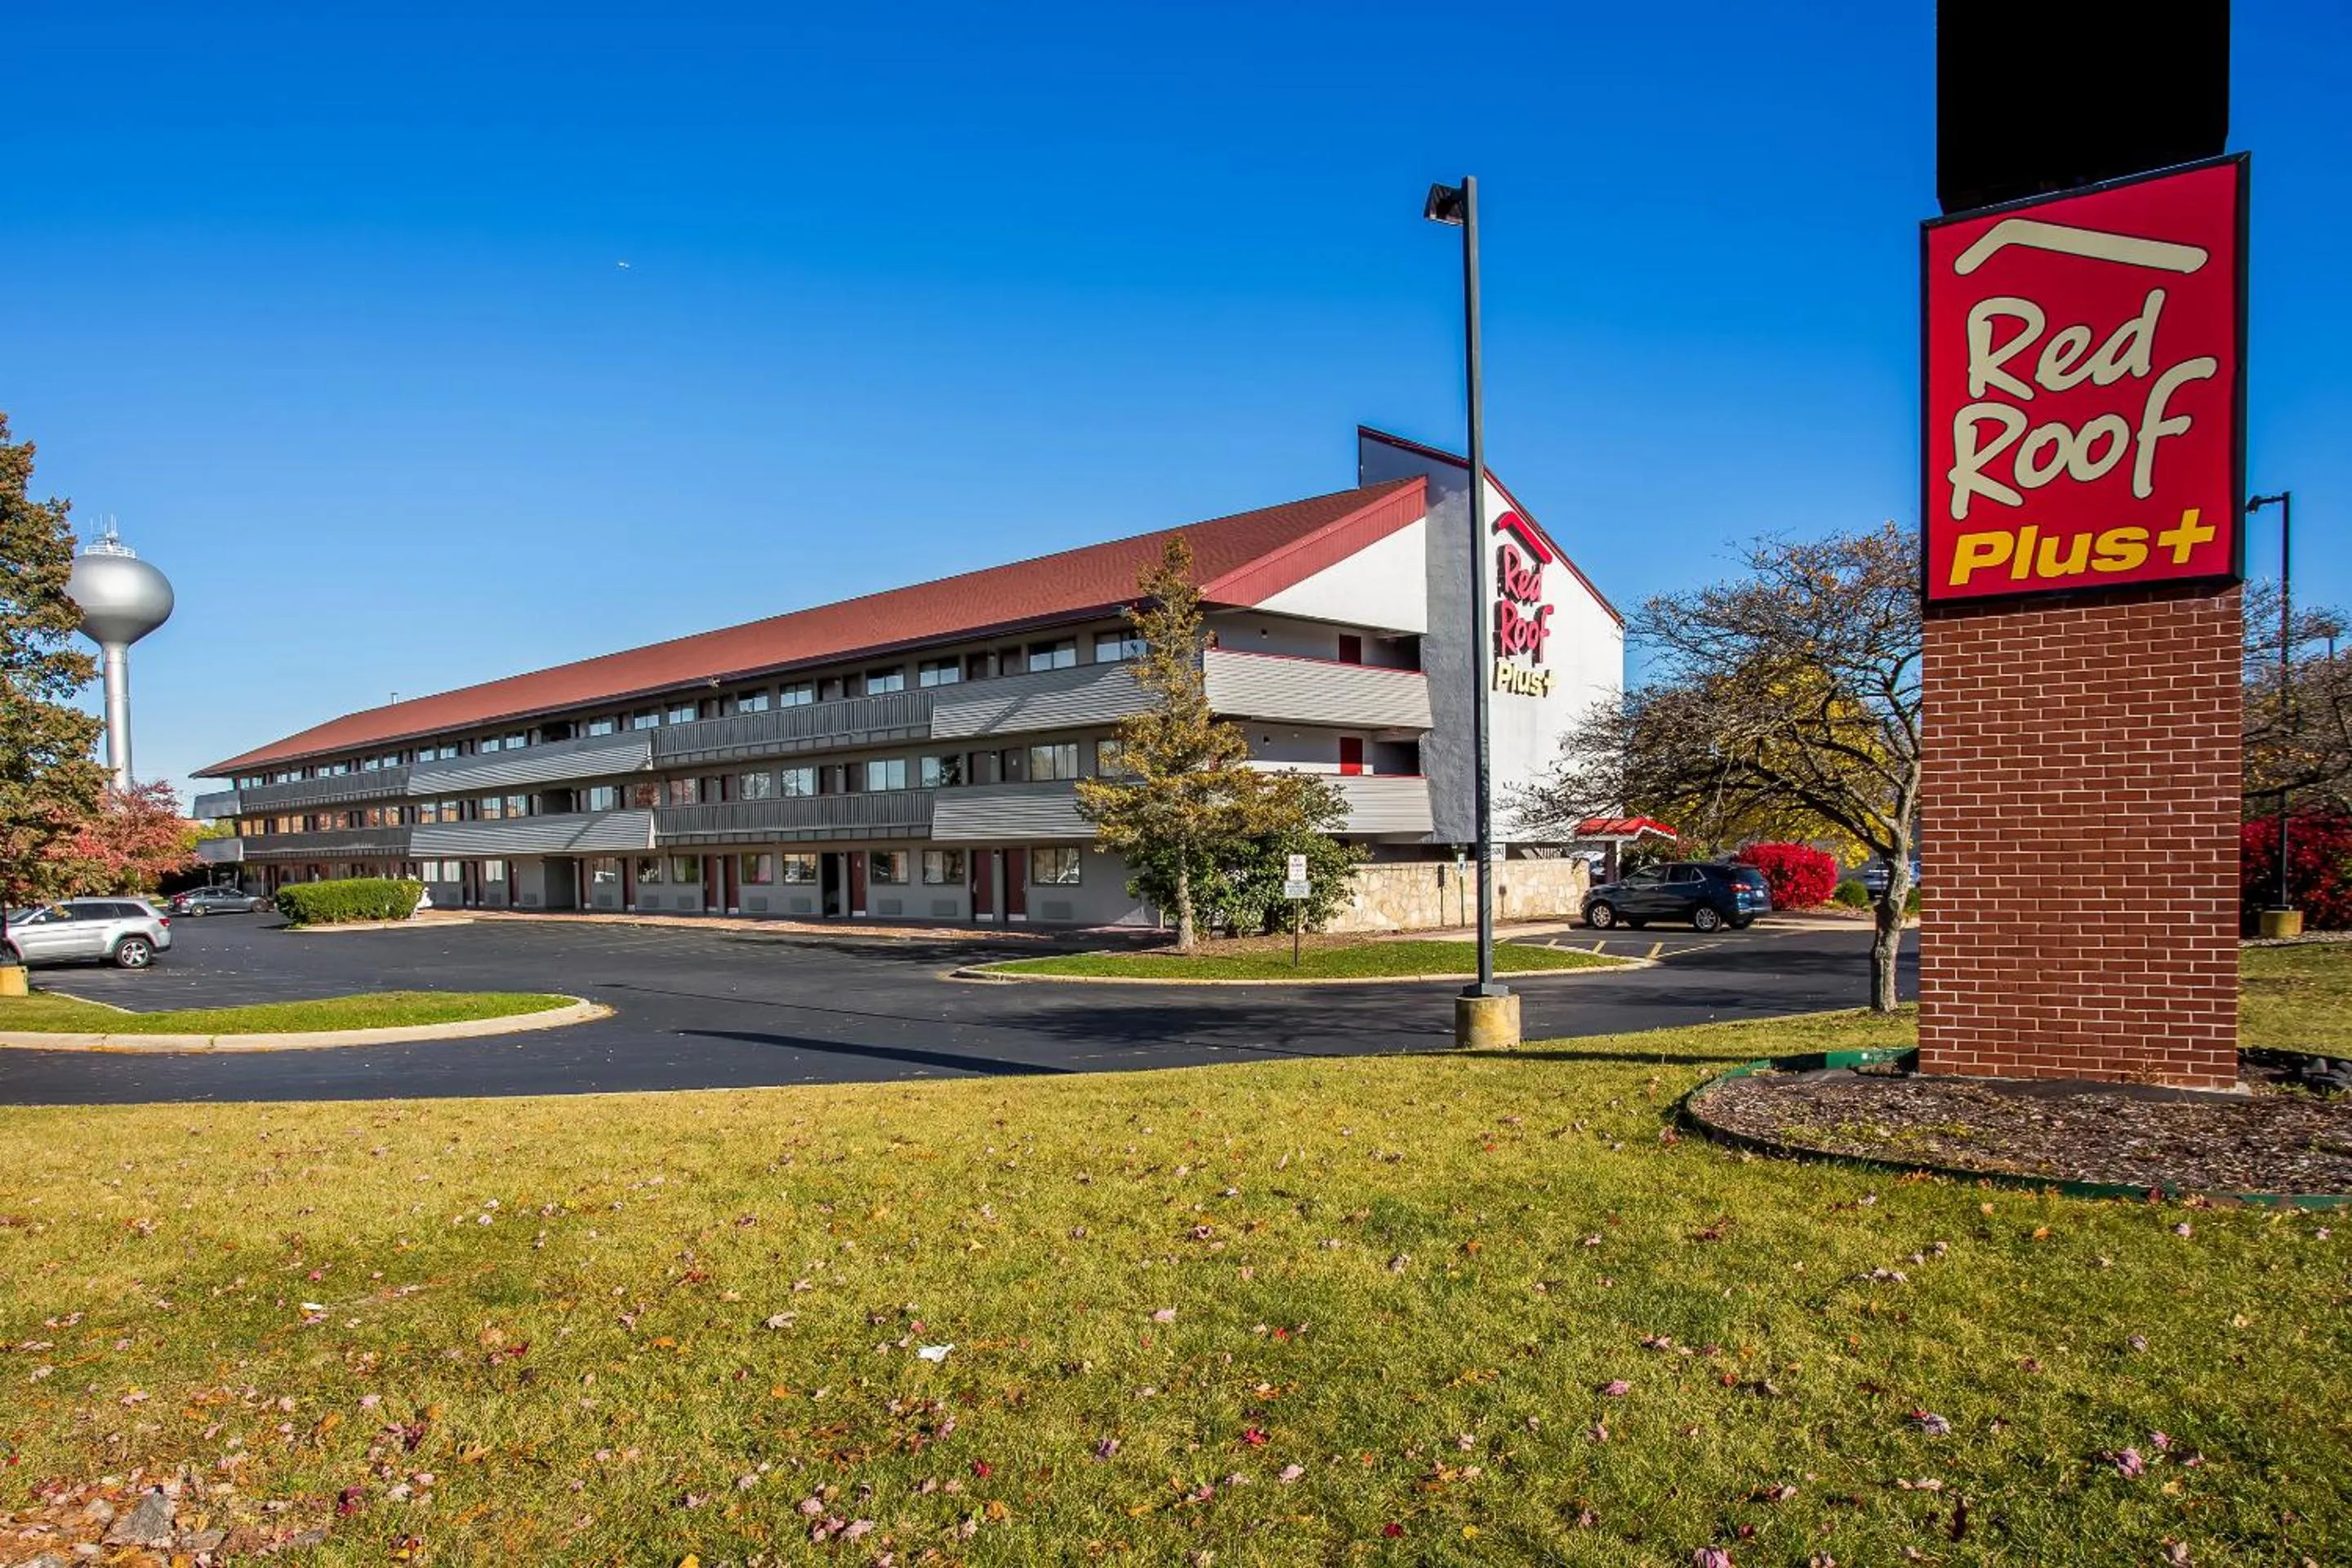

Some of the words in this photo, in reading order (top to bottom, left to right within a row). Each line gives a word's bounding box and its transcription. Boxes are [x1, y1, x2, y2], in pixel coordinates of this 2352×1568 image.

[1967, 288, 2166, 399] Red
[1947, 357, 2217, 519] Roof
[1500, 544, 1544, 603] Red
[1949, 509, 2216, 585] Plus+
[1498, 600, 1555, 665] Roof
